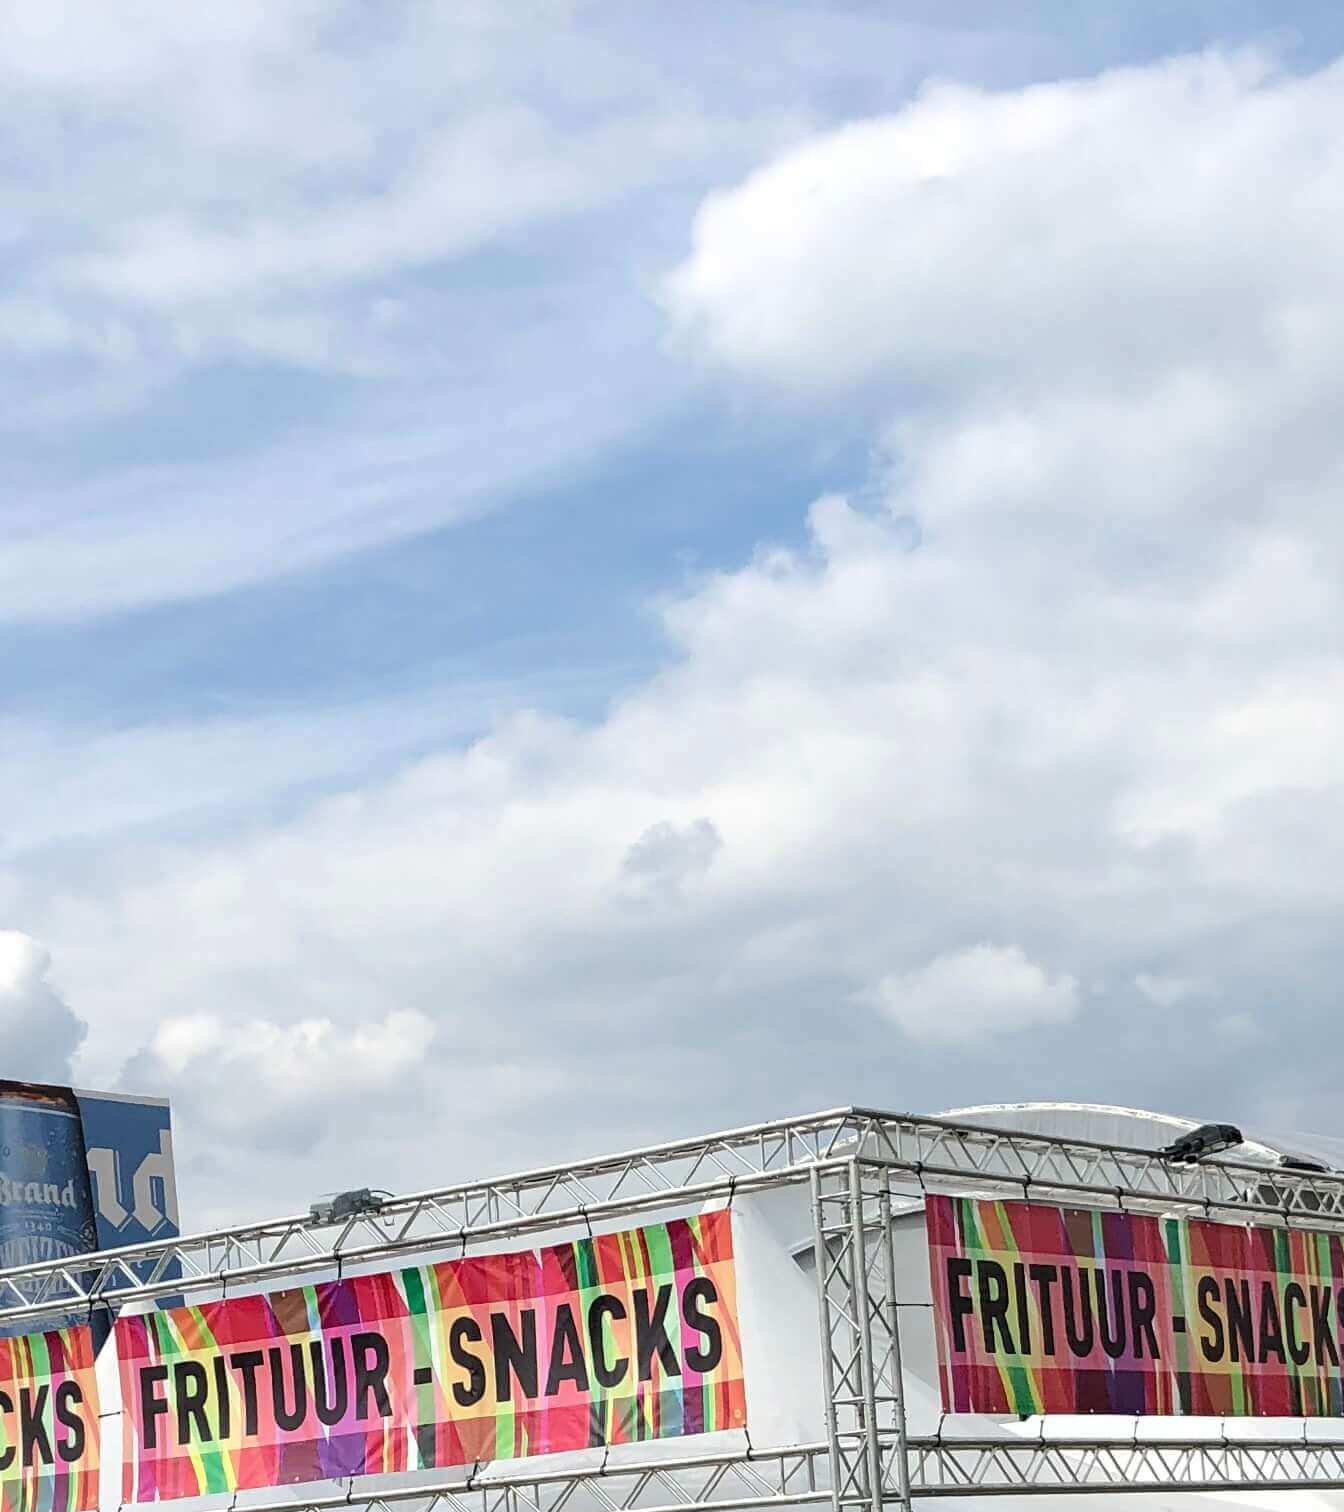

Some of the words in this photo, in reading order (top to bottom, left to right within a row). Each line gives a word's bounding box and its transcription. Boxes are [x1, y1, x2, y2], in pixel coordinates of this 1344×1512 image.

[140, 1332, 394, 1451] FRITUUR
[448, 1275, 724, 1407] SNACKS
[946, 1257, 1161, 1361] FRITUUR
